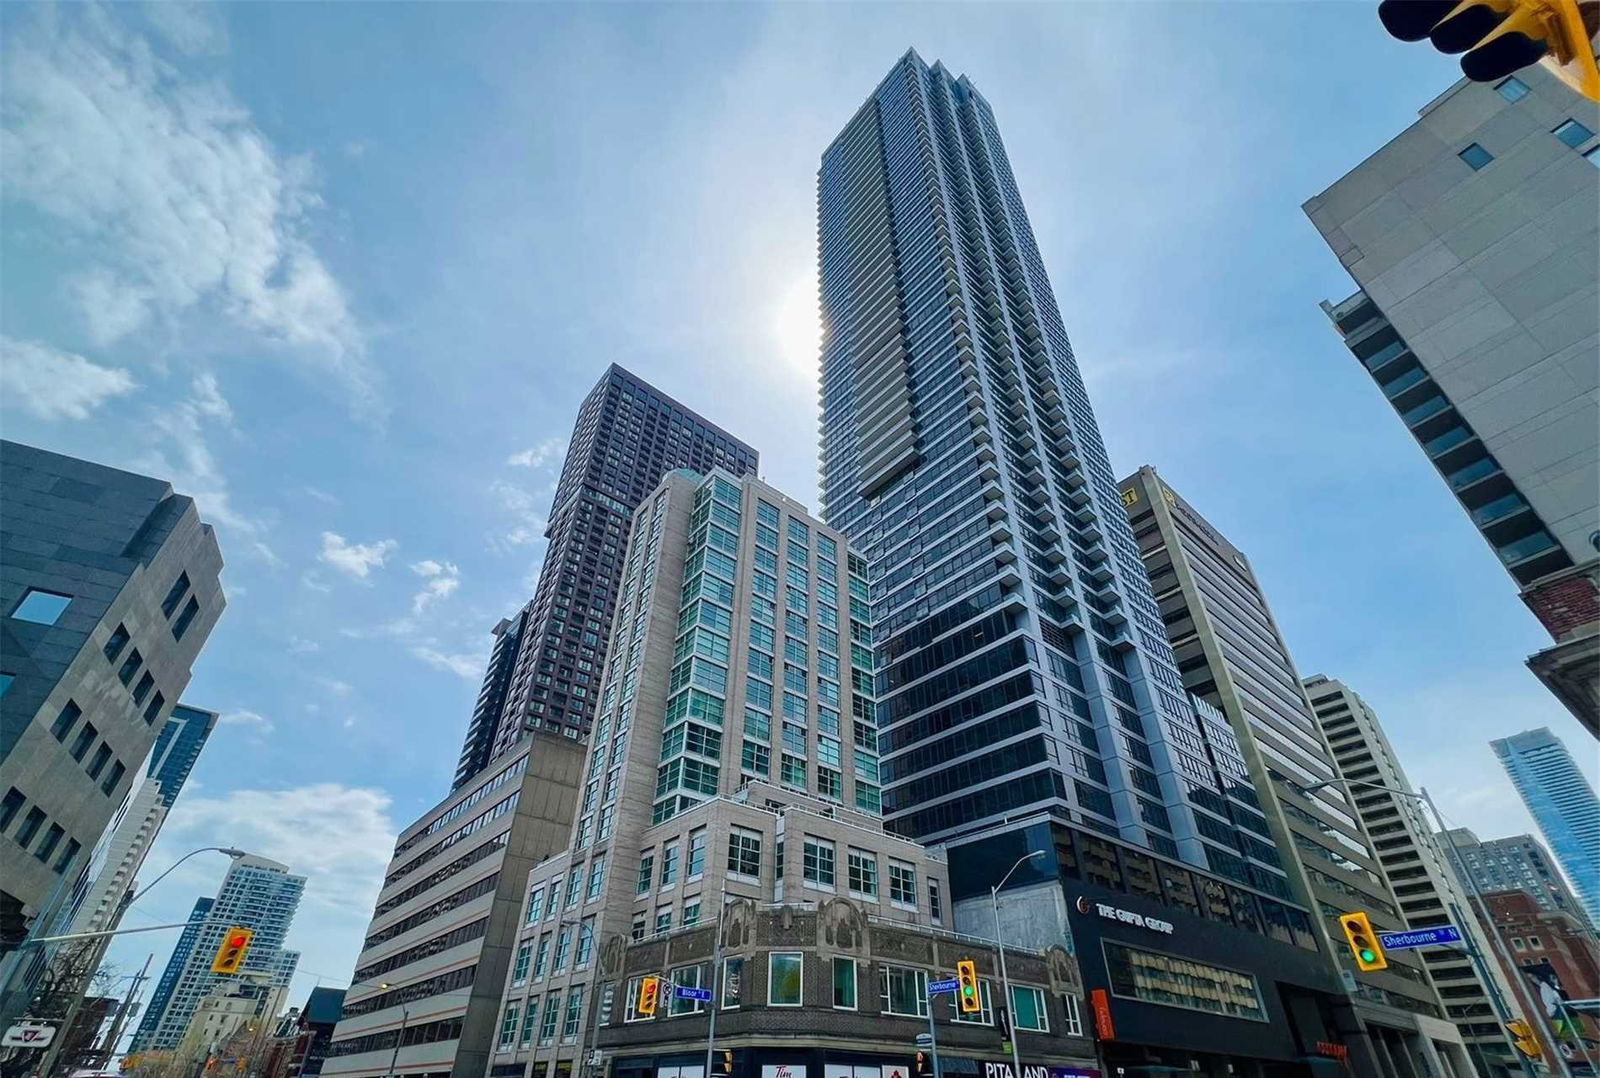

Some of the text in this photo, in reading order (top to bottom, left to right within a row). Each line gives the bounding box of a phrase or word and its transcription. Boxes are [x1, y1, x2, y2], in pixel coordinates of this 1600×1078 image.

[1096, 903, 1116, 919] THE
[1383, 932, 1437, 946] Sherbourne
[1448, 928, 1458, 939] N
[682, 988, 697, 997] Bloor
[929, 982, 956, 991] Sherbourne
